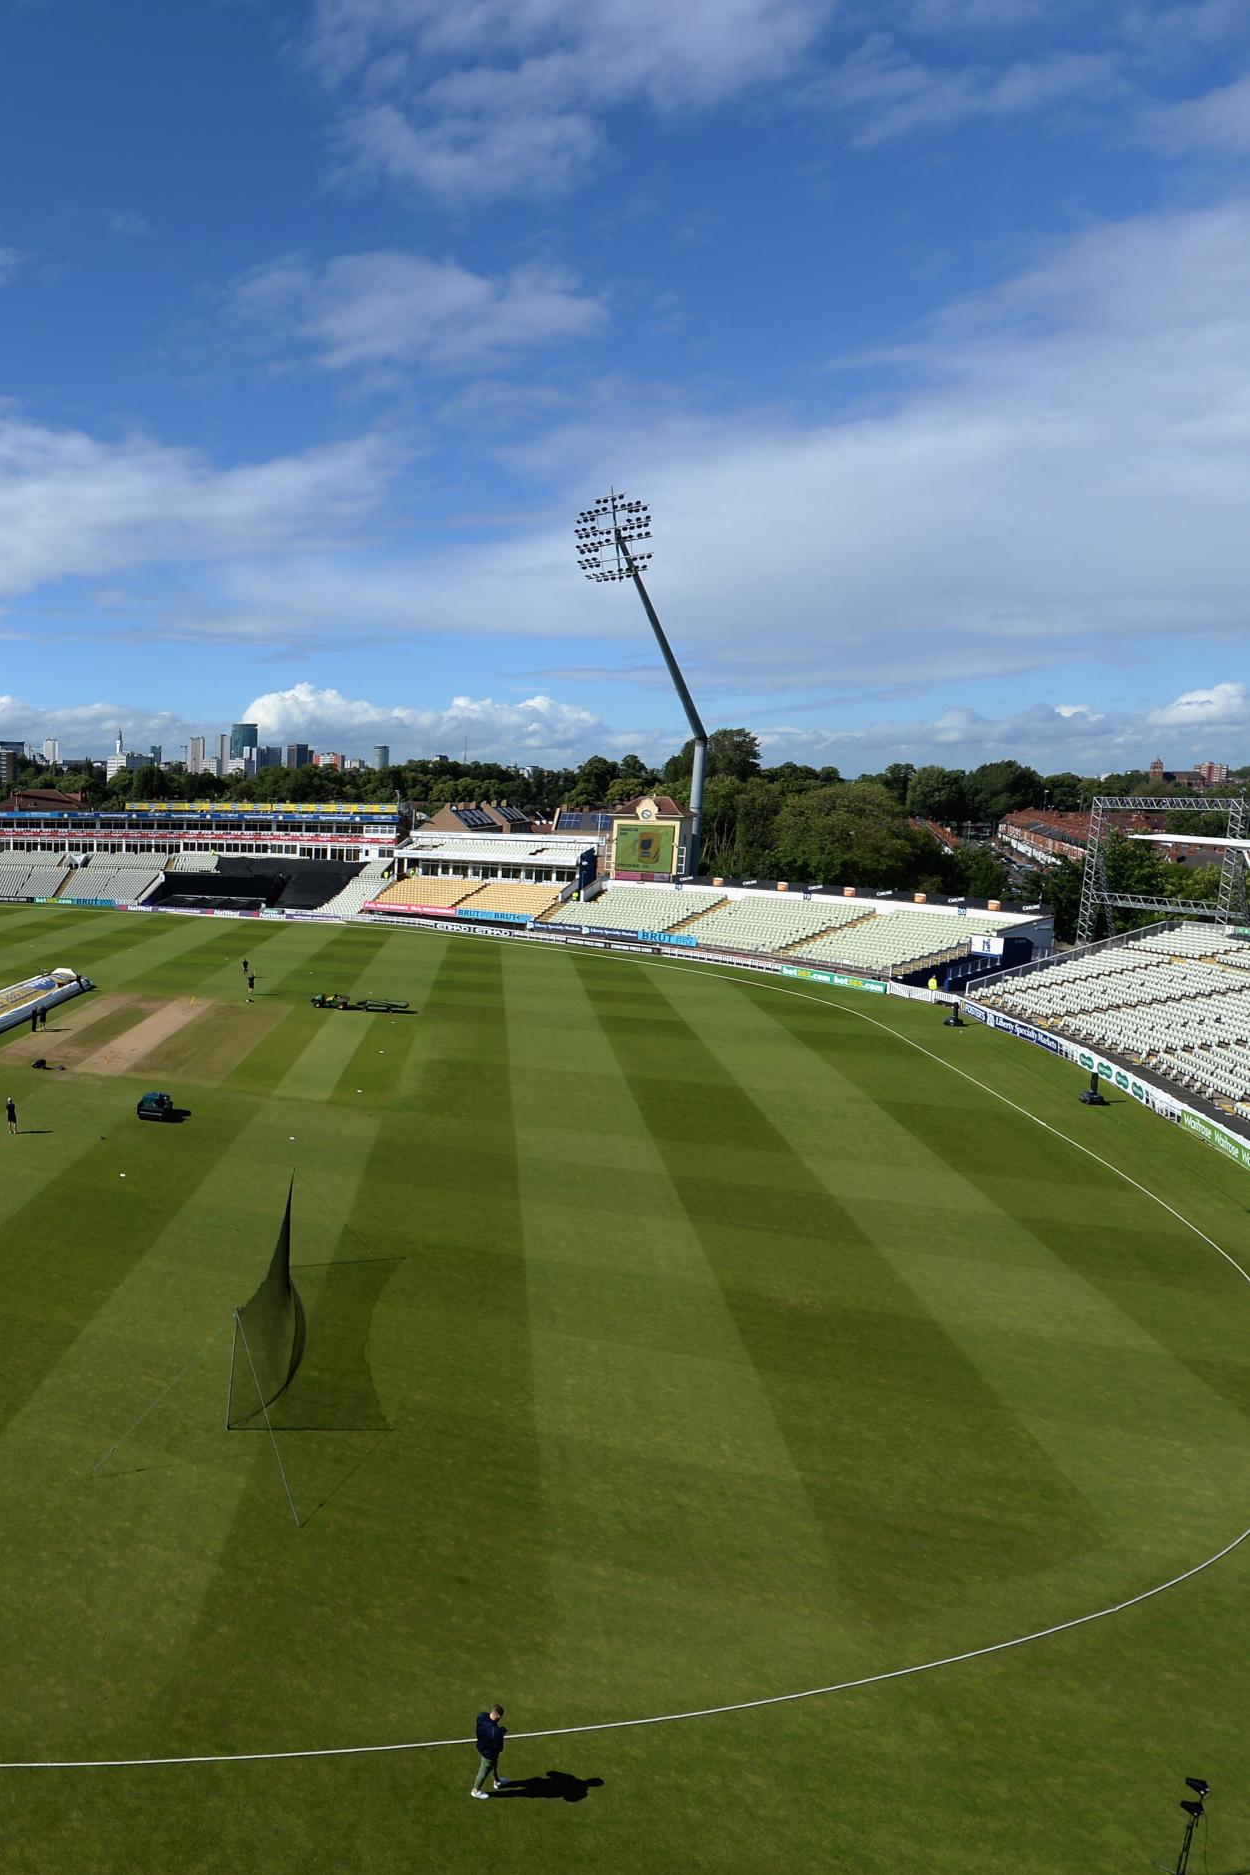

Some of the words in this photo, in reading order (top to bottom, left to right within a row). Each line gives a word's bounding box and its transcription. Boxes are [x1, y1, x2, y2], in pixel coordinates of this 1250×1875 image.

[436, 923, 470, 932] ETIHAD
[476, 928, 510, 937] ETIHAD
[642, 932, 674, 942] BRUT
[782, 966, 830, 982] bet365.com
[834, 976, 884, 992] bet365.com
[964, 1004, 986, 1020] FOSTER'S
[996, 1016, 1014, 1032] Liberty
[1015, 1024, 1037, 1042] Specialty
[1037, 1033, 1056, 1050] Markets
[1183, 1112, 1212, 1138] Waitrose
[1214, 1130, 1239, 1158] Waitrose
